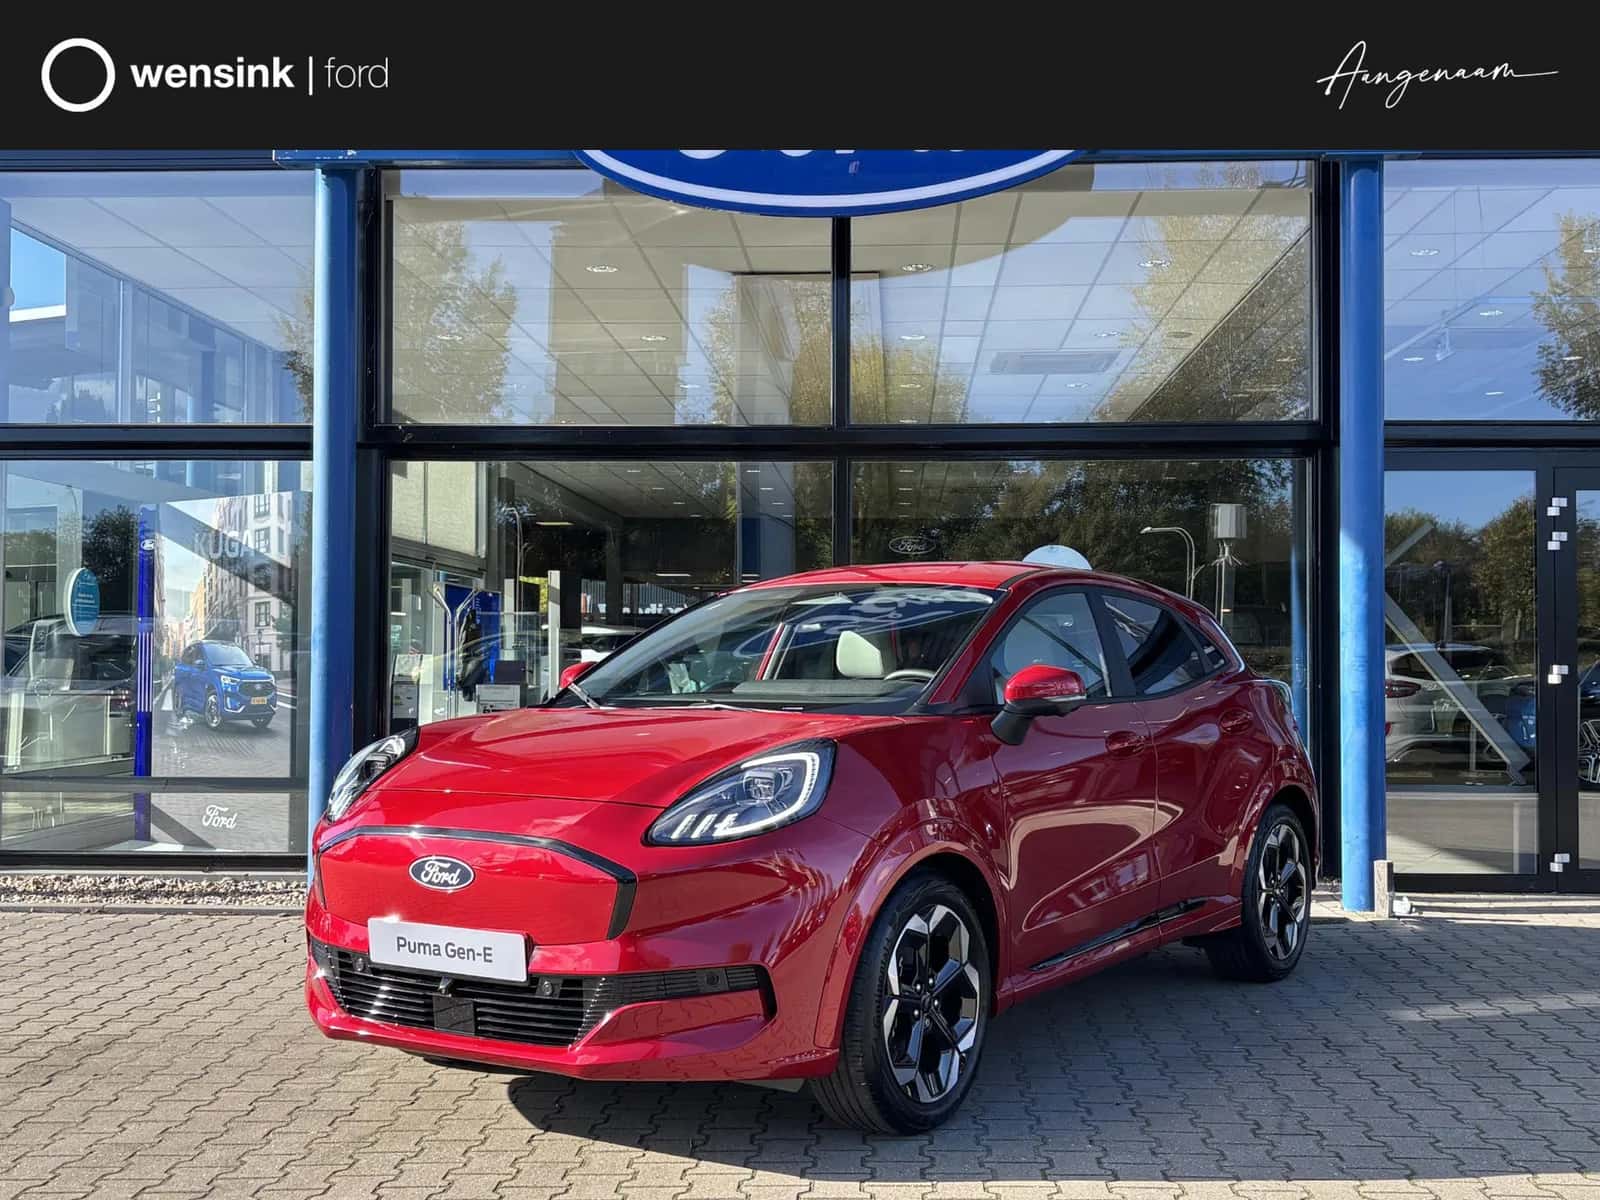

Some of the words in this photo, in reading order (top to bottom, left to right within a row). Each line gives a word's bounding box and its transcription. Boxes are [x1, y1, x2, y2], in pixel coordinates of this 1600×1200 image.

[194, 529, 256, 559] KUGA
[202, 804, 238, 829] Ford
[420, 860, 462, 885] Ford
[396, 936, 441, 956] Puma
[444, 942, 493, 963] Gen-E
